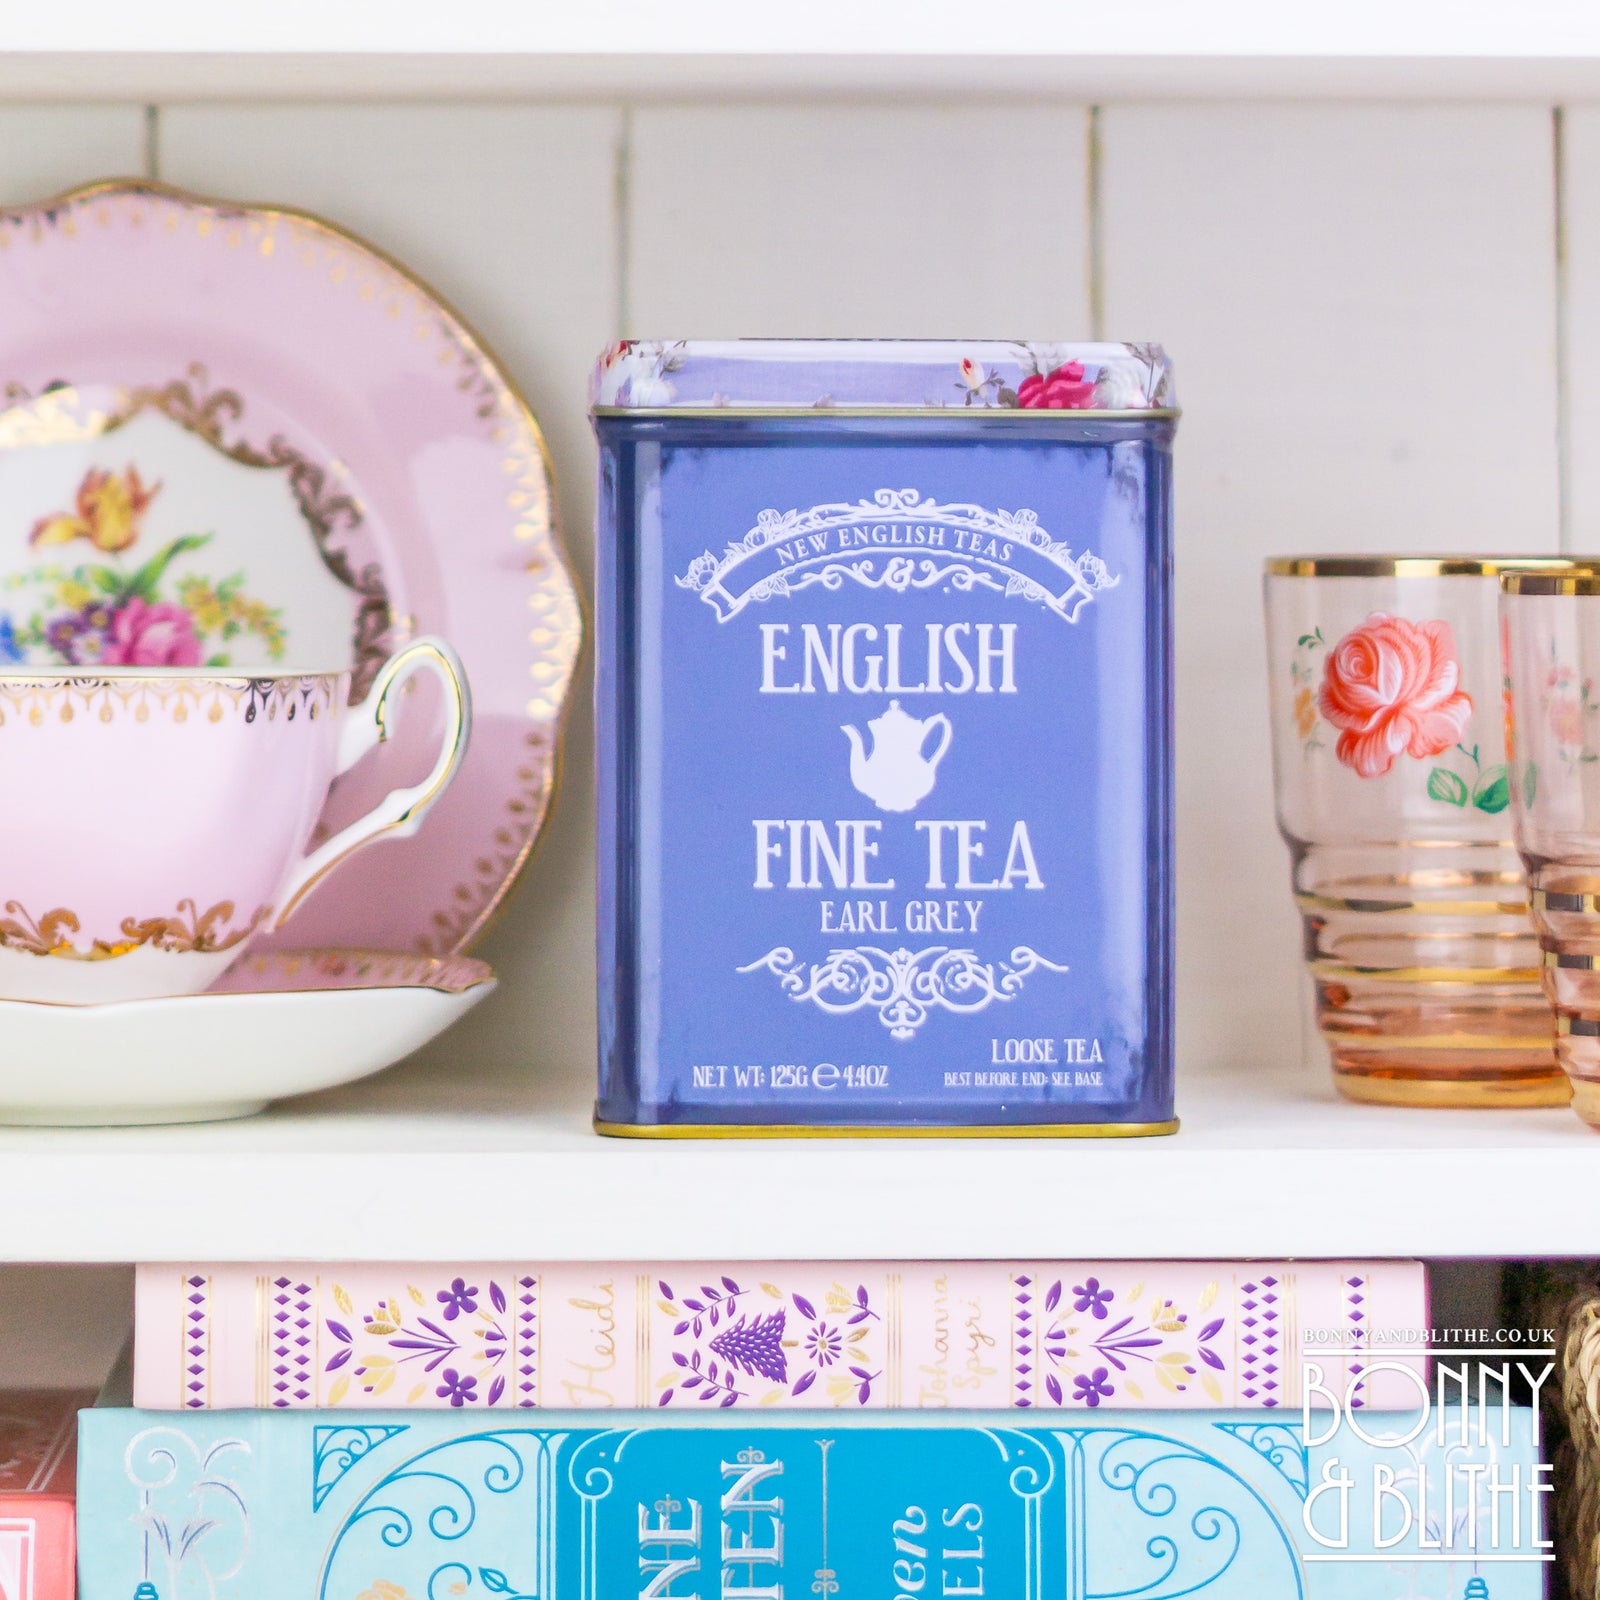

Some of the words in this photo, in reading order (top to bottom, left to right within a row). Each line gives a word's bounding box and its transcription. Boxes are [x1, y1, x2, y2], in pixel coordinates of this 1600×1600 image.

[776, 531, 829, 565] NEW
[837, 524, 944, 547] ENGLISH
[953, 528, 1013, 561] TEAS
[759, 622, 1018, 694] ENGLISH
[752, 819, 895, 889] FINE
[915, 819, 1045, 889] TEA
[820, 901, 897, 933] EARL
[905, 901, 983, 933] GREY
[991, 1038, 1058, 1064] LOOSE
[1064, 1038, 1104, 1063] TEA
[693, 1065, 728, 1088] NET
[733, 1065, 765, 1088] WT:
[770, 1064, 808, 1088] 125G
[944, 1071, 972, 1086] BEST
[974, 1071, 1018, 1086] BEFORE
[1022, 1071, 1049, 1086] END:
[1052, 1071, 1072, 1086] SEE
[1075, 1071, 1103, 1086] BASE
[561, 1279, 616, 1407] Heidi
[918, 1272, 949, 1408] Johanna
